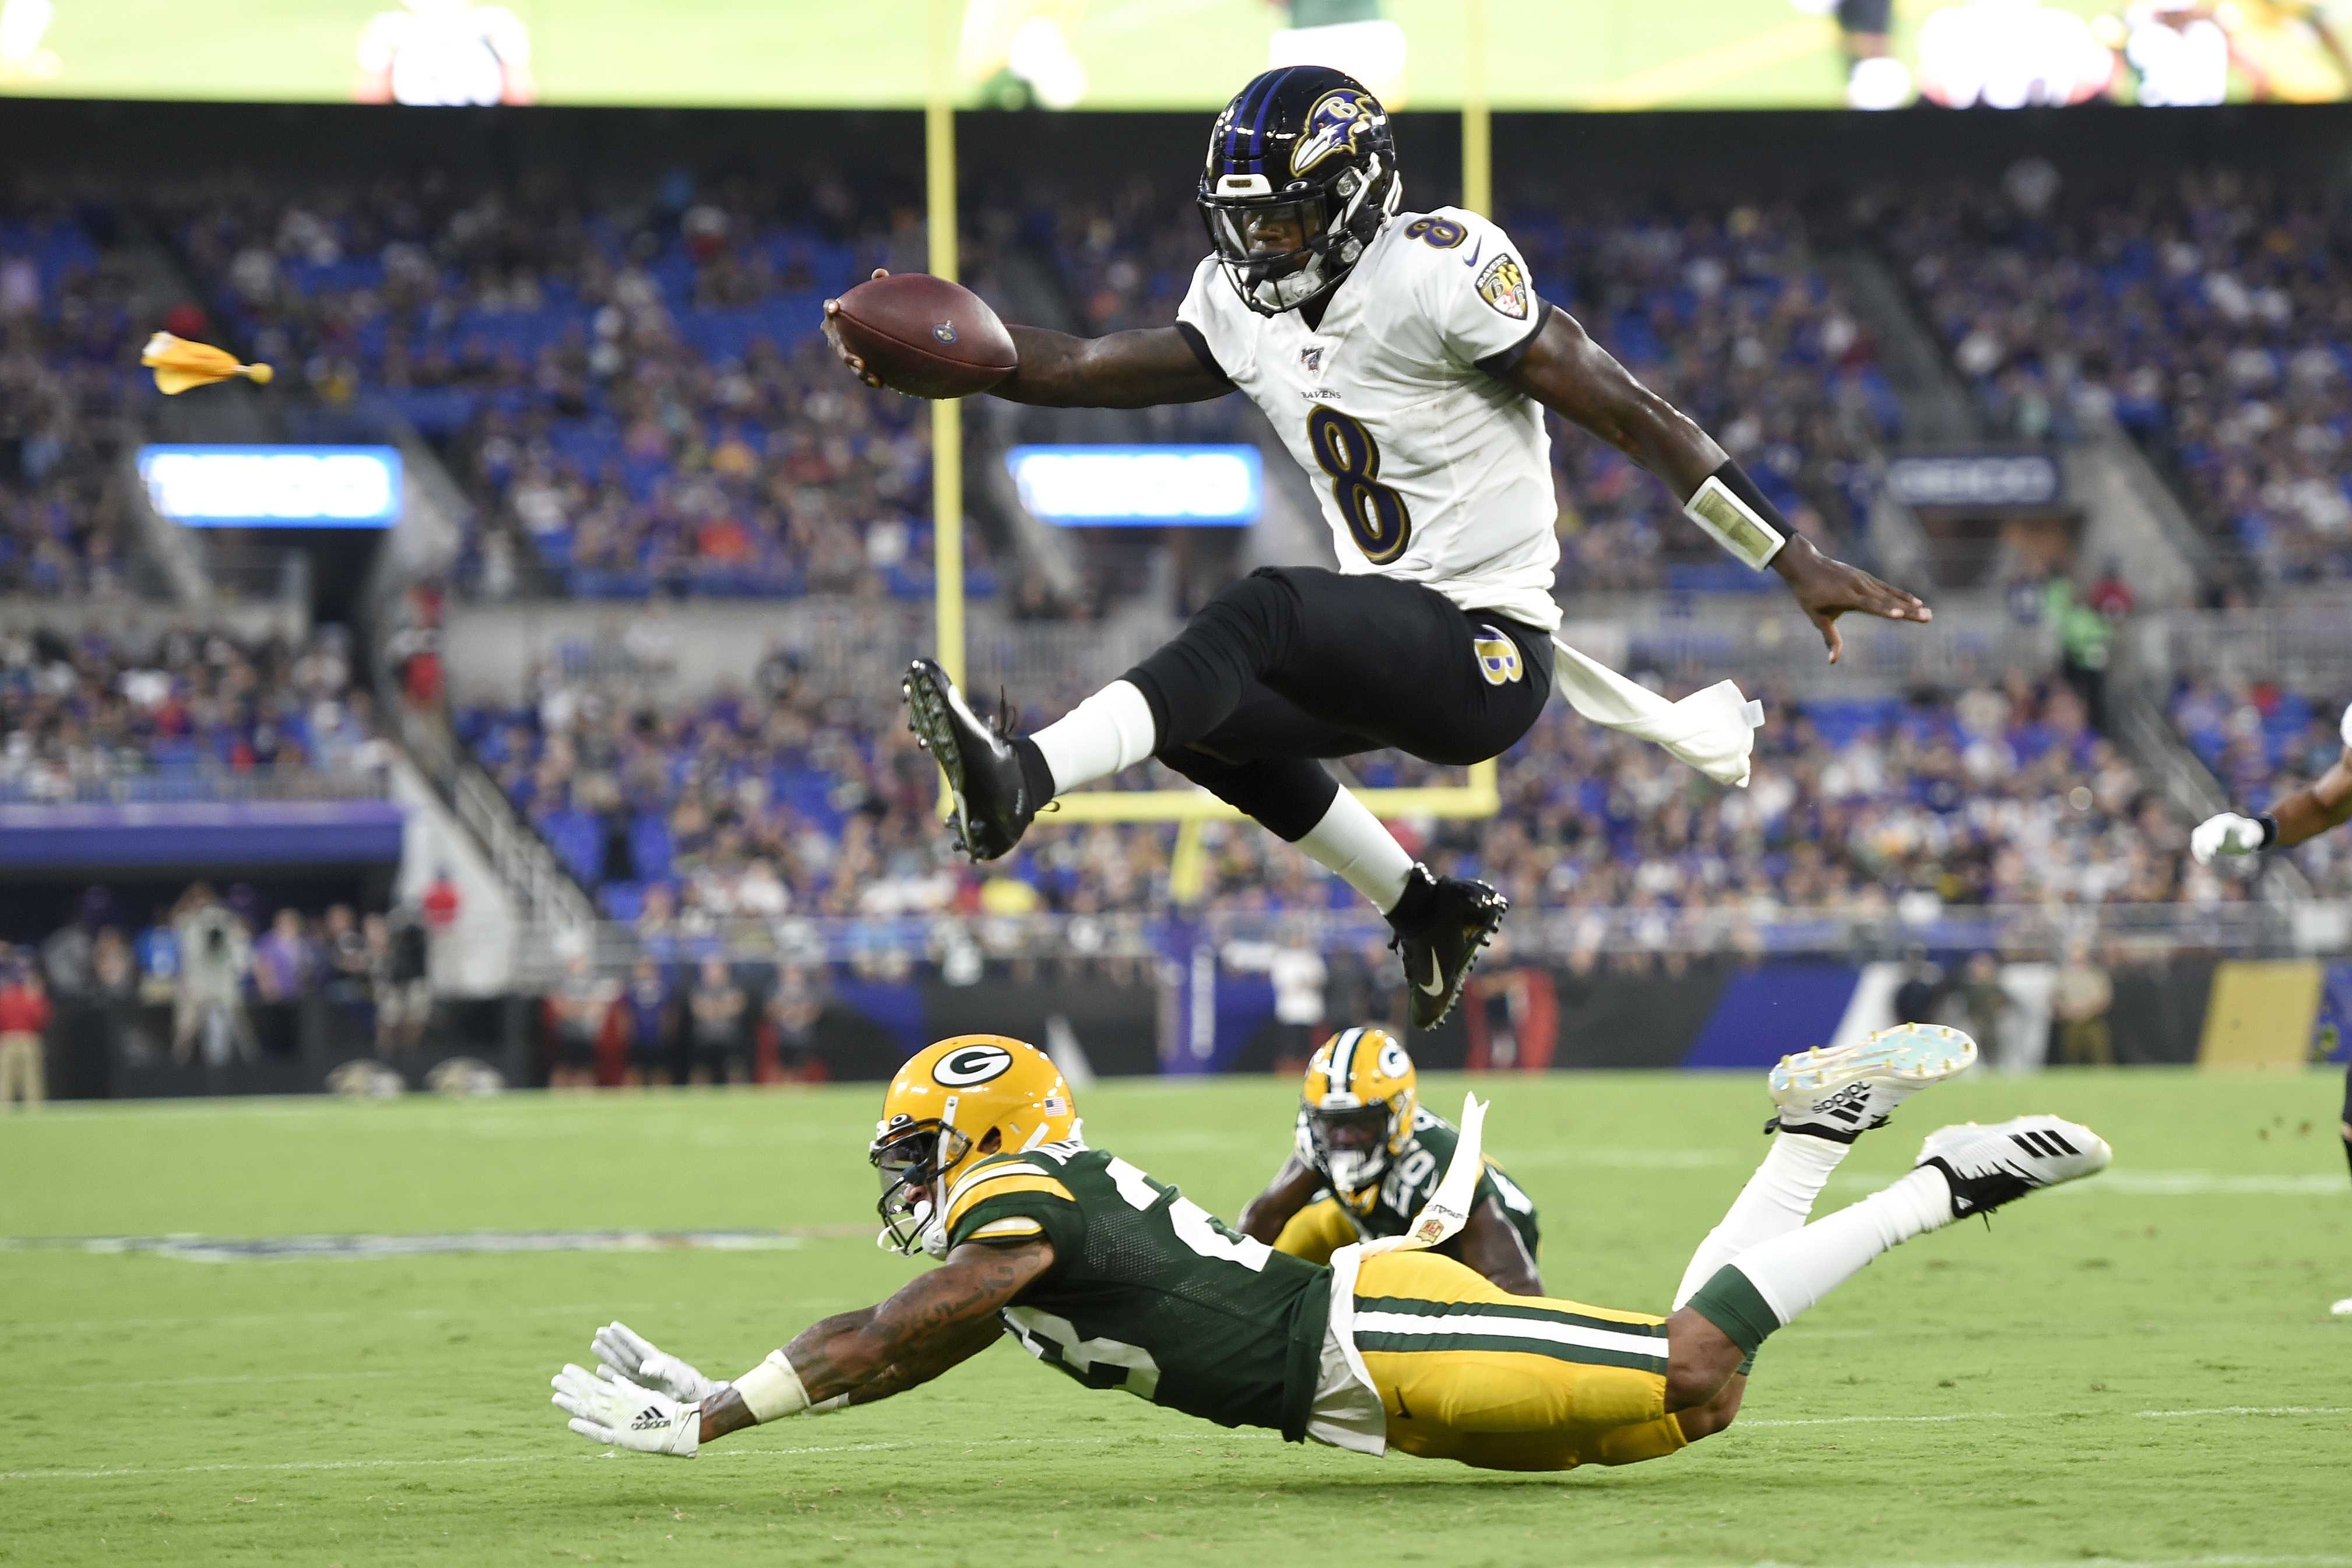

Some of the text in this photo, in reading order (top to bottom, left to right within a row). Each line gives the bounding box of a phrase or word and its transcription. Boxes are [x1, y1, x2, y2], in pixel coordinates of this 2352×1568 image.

[1404, 216, 1468, 249] 8
[1476, 254, 1509, 287] RAVENS
[1300, 391, 1342, 399] RAVENS
[1306, 404, 1412, 565] 8
[1474, 624, 1523, 685] B
[931, 1045, 1014, 1088] G
